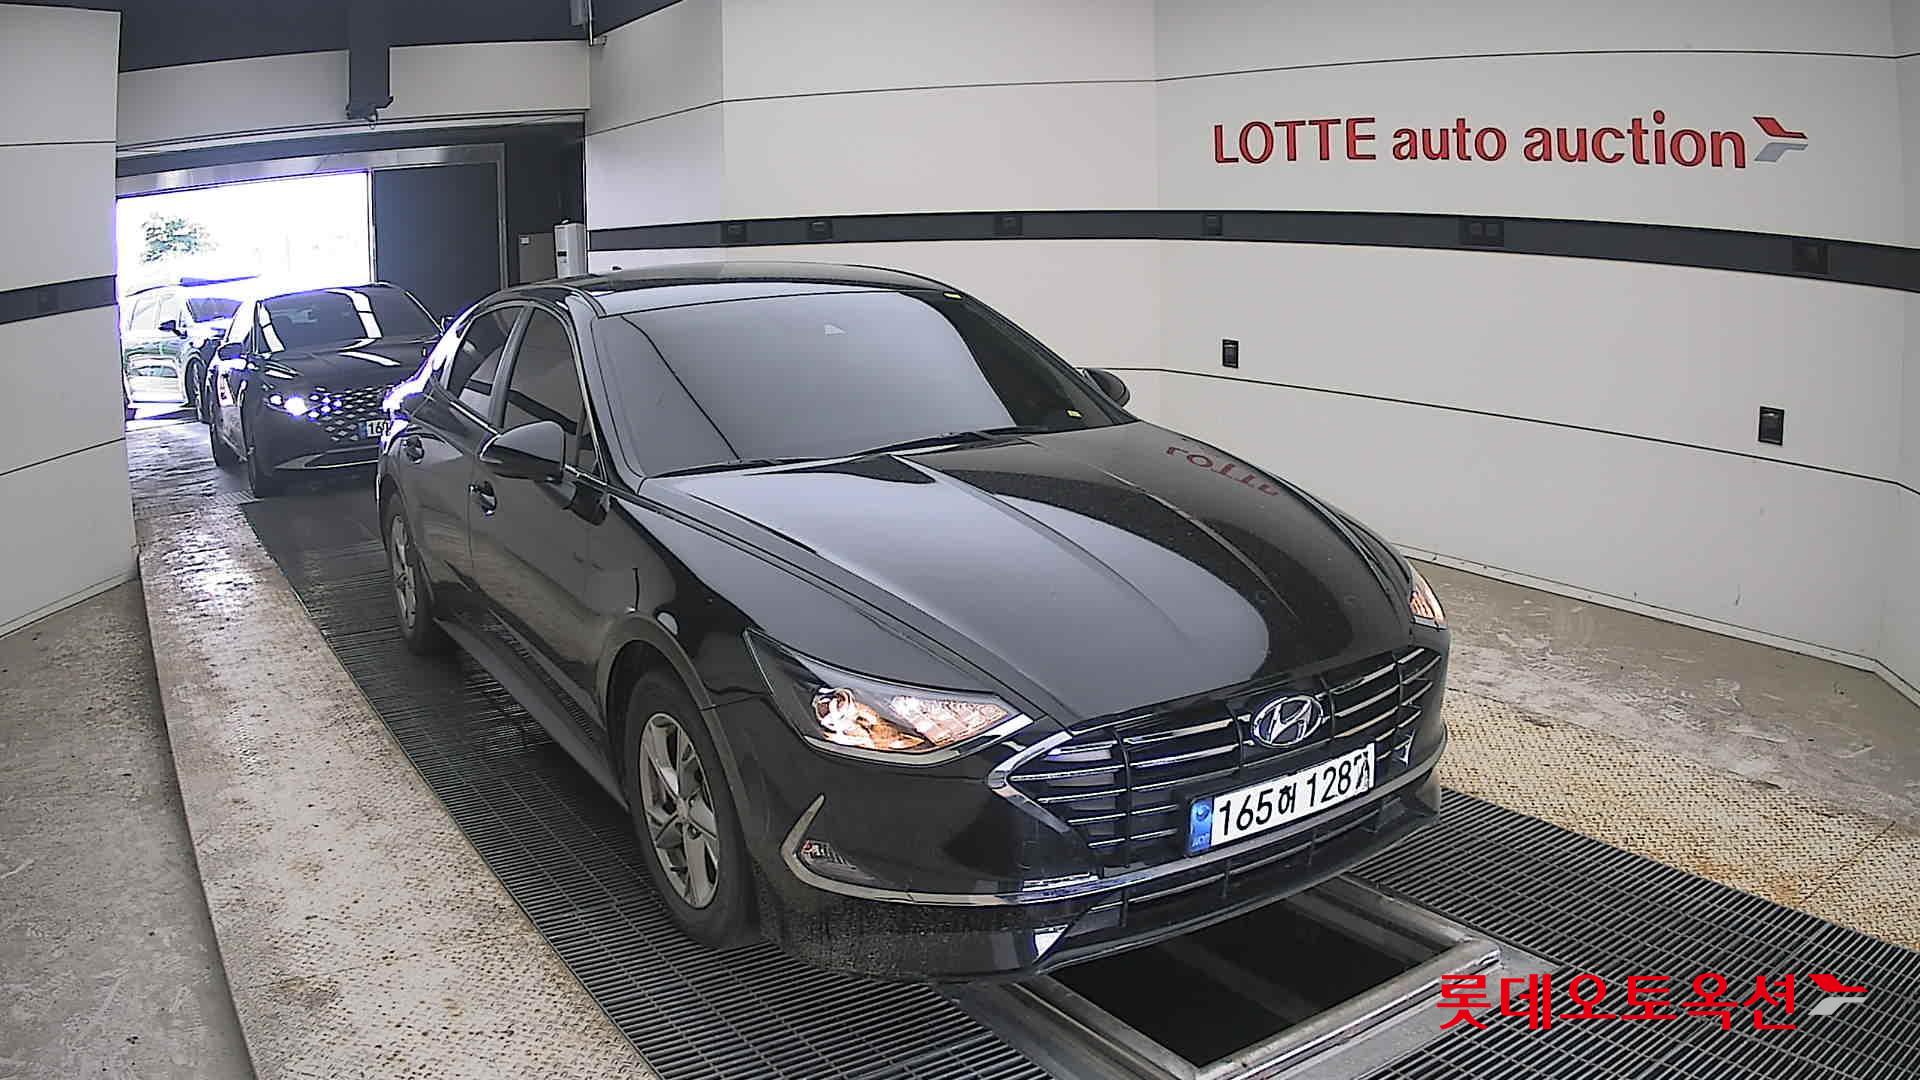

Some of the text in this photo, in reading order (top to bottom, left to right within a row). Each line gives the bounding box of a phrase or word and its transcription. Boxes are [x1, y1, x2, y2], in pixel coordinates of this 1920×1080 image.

[1214, 110, 1746, 168] LOTTE auto auction
